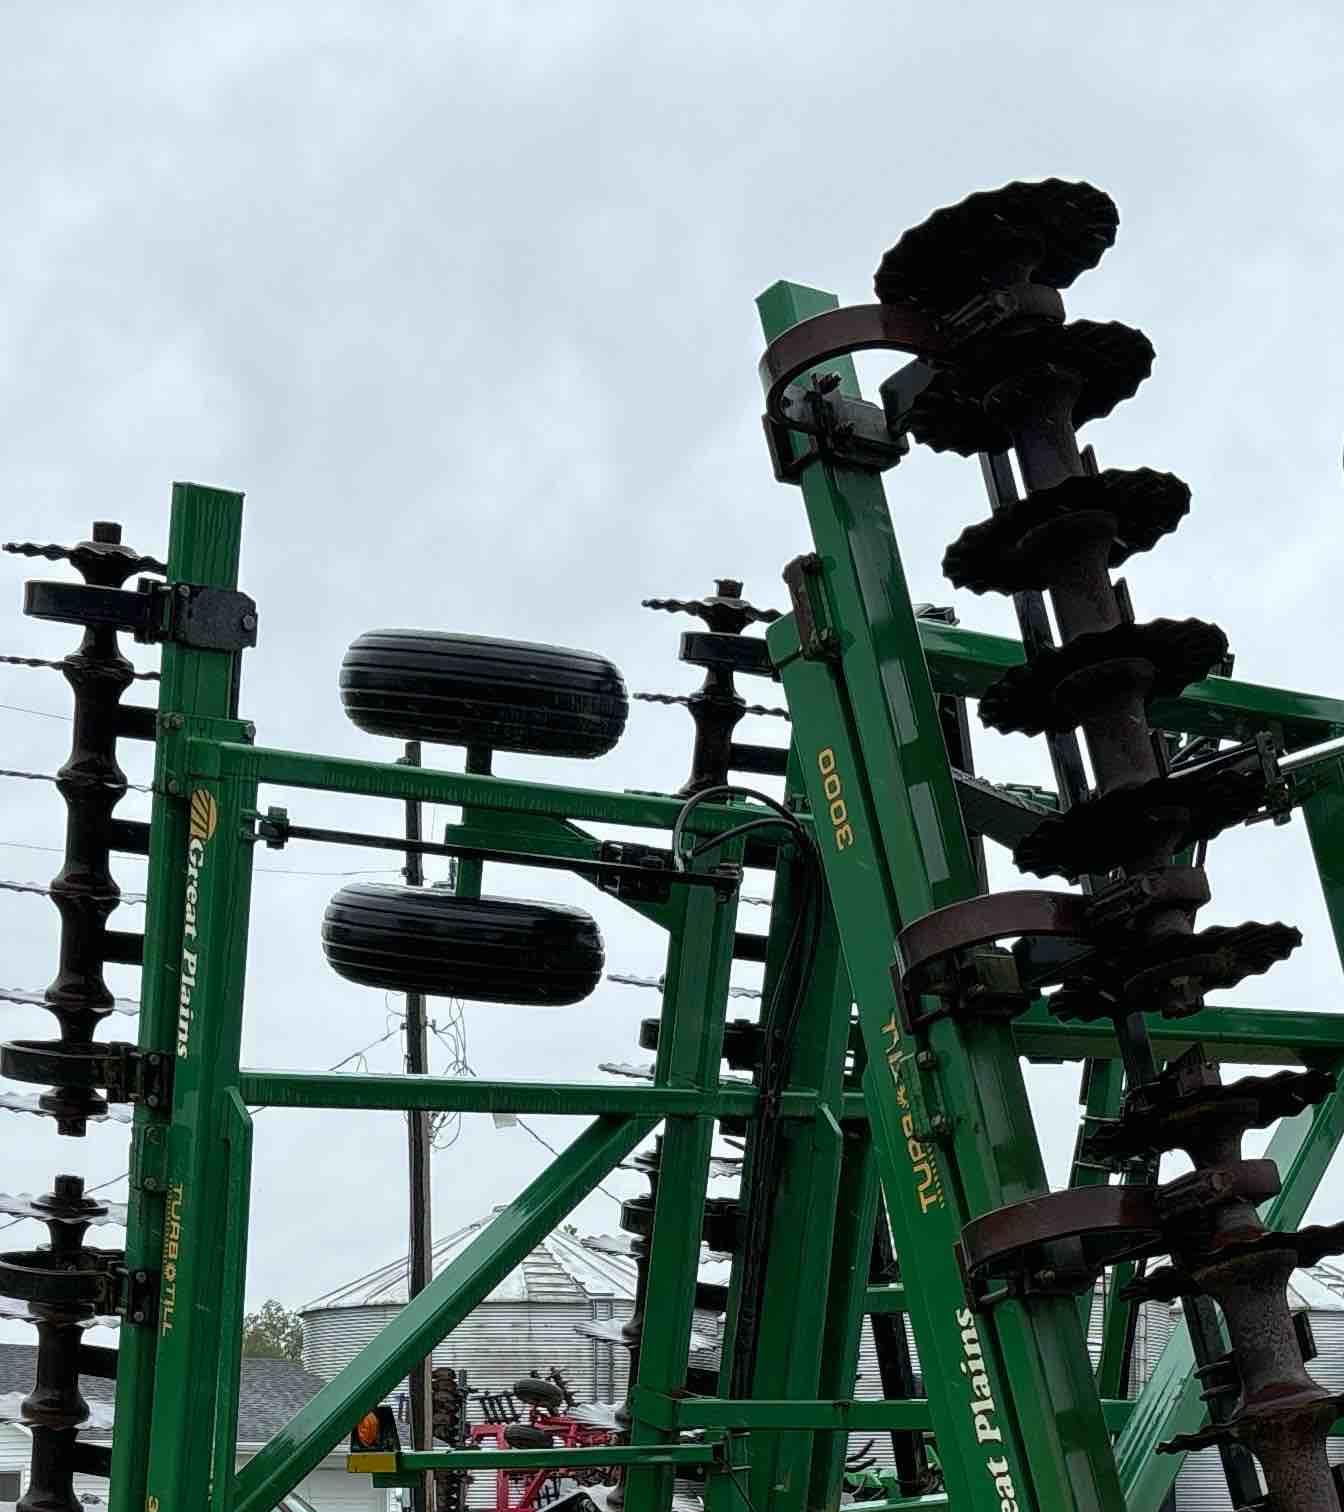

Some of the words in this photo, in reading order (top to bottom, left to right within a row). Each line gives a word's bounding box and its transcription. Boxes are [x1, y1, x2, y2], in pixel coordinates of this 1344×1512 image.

[818, 748, 854, 851] 3000
[184, 837, 205, 938] Great
[176, 948, 197, 1059] Plains
[956, 1307, 1003, 1445] Plains
